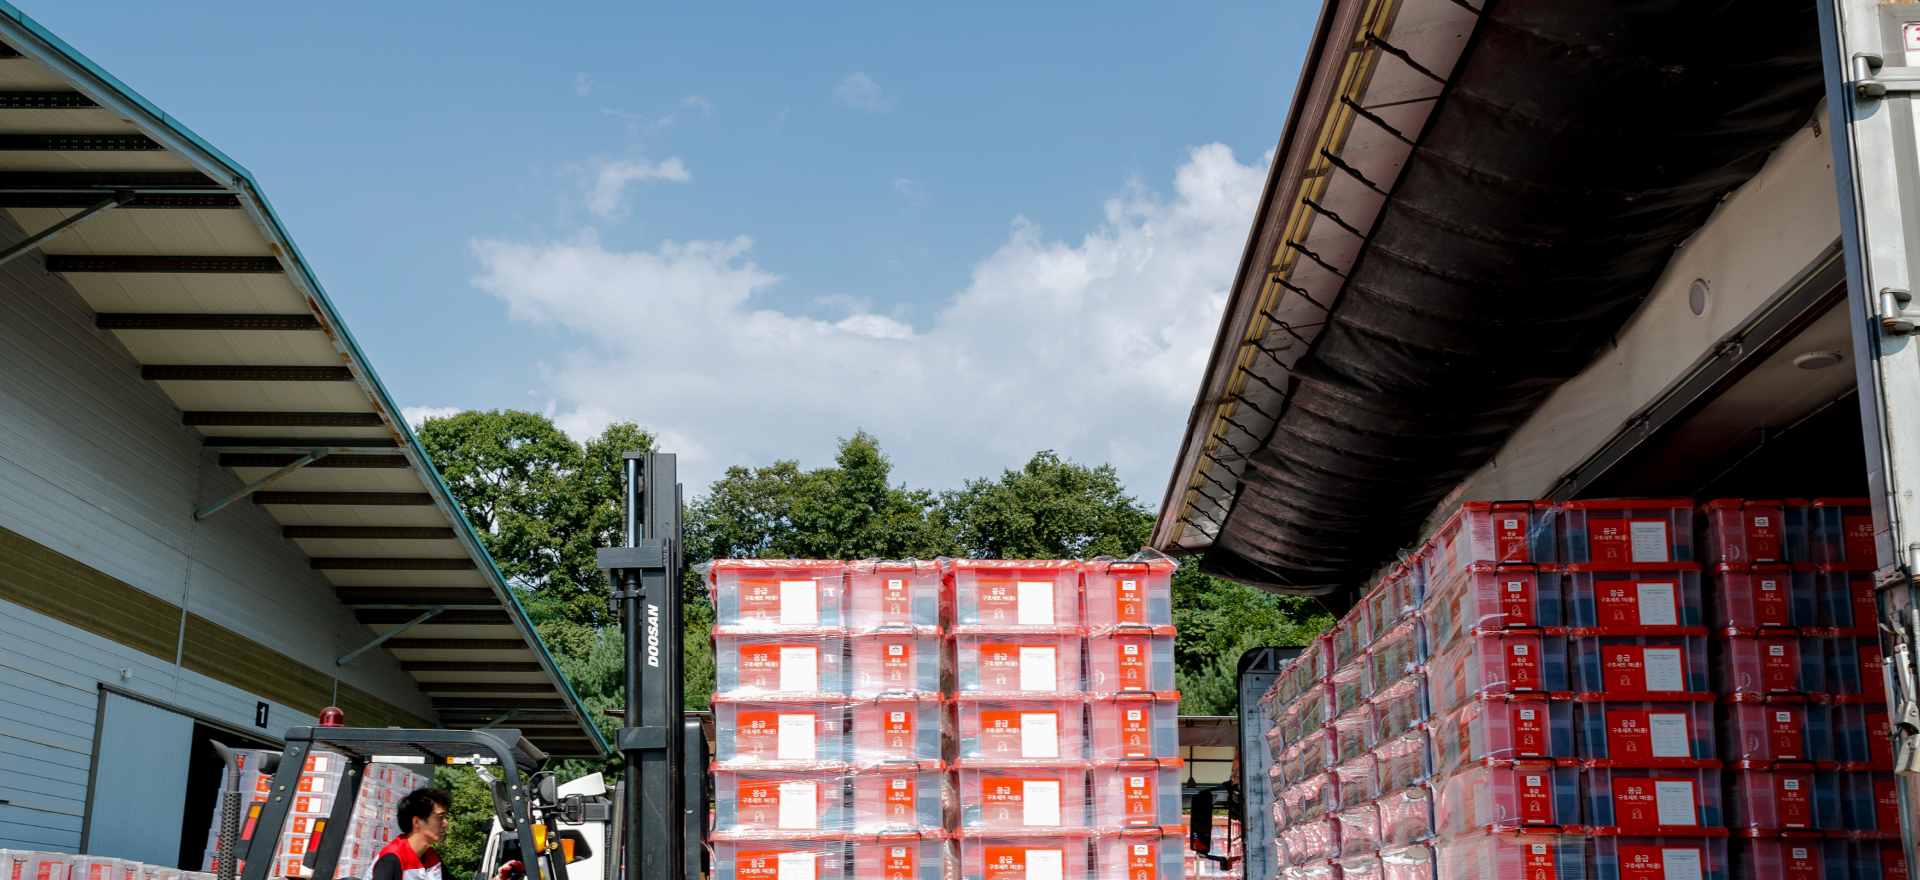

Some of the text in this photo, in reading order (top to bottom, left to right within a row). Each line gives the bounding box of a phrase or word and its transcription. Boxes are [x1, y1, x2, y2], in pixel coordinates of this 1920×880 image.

[648, 604, 658, 668] DOOSAN
[260, 706, 265, 724] 1
[751, 859, 765, 868] 응급
